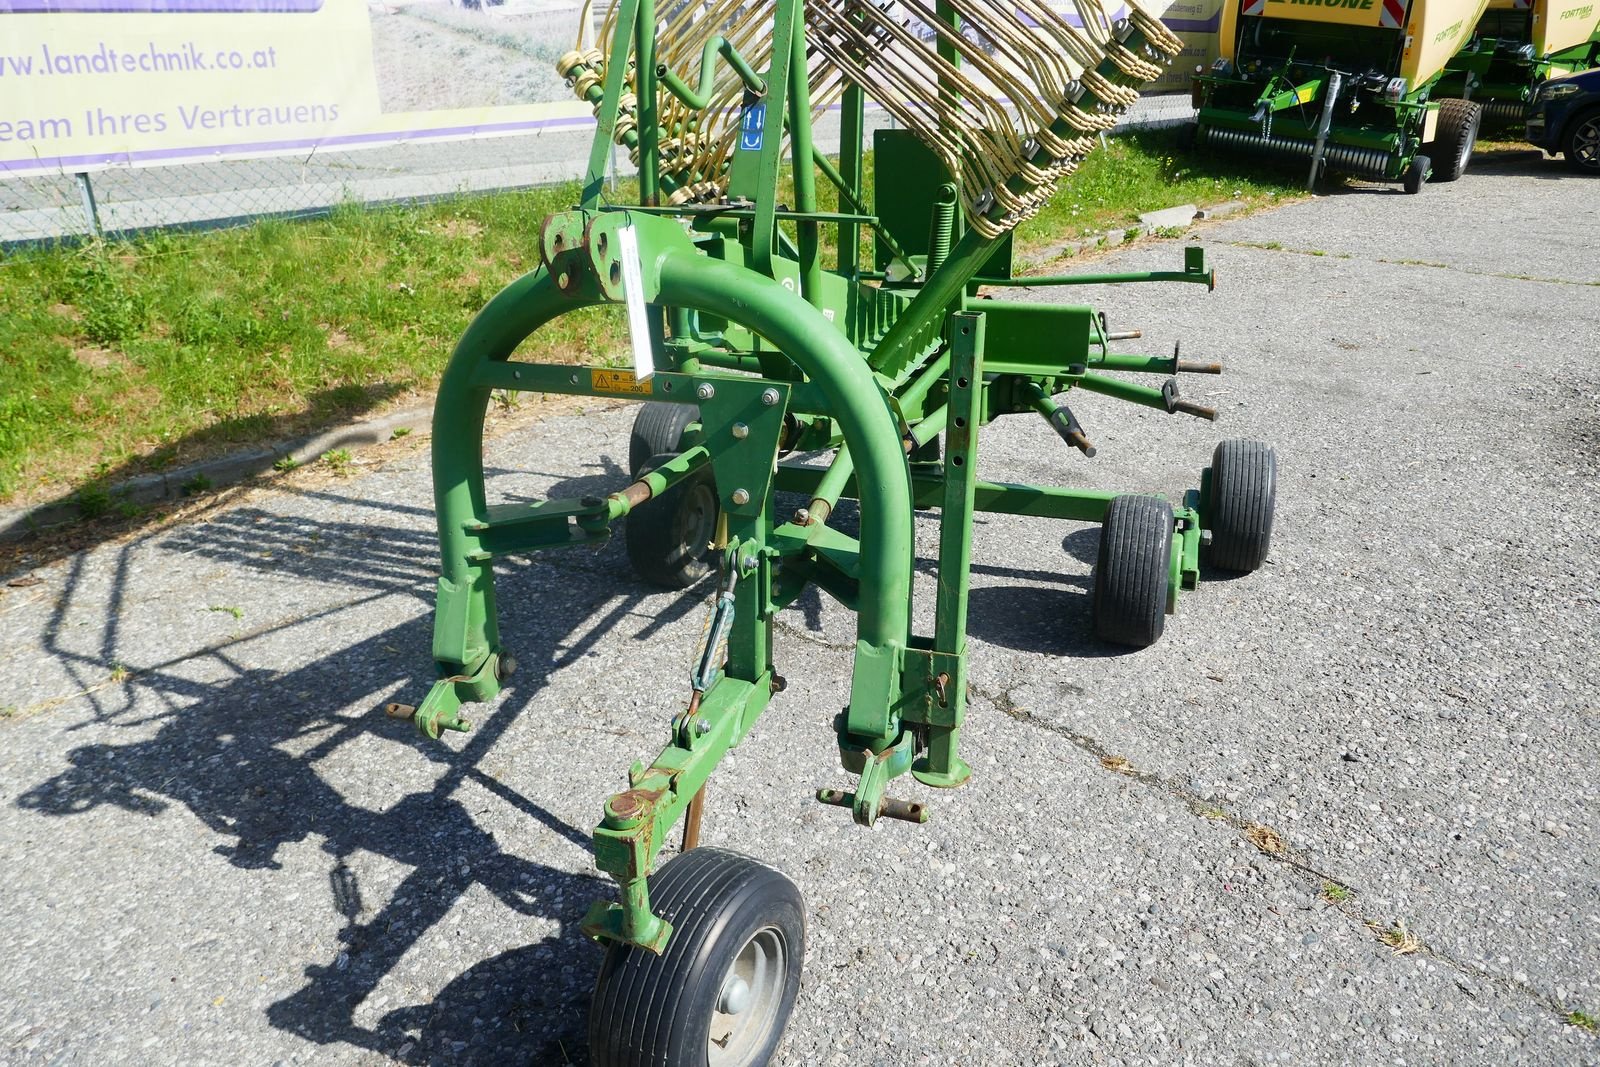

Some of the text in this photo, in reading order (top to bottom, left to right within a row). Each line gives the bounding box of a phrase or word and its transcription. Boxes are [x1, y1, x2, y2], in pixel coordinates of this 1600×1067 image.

[1560, 4, 1593, 20] FORTIMA
[1433, 19, 1463, 44] FORTIMA
[0, 42, 277, 77] w.landtechnik.co.at
[86, 108, 168, 137] Ihres
[178, 103, 340, 131] Vertrauens
